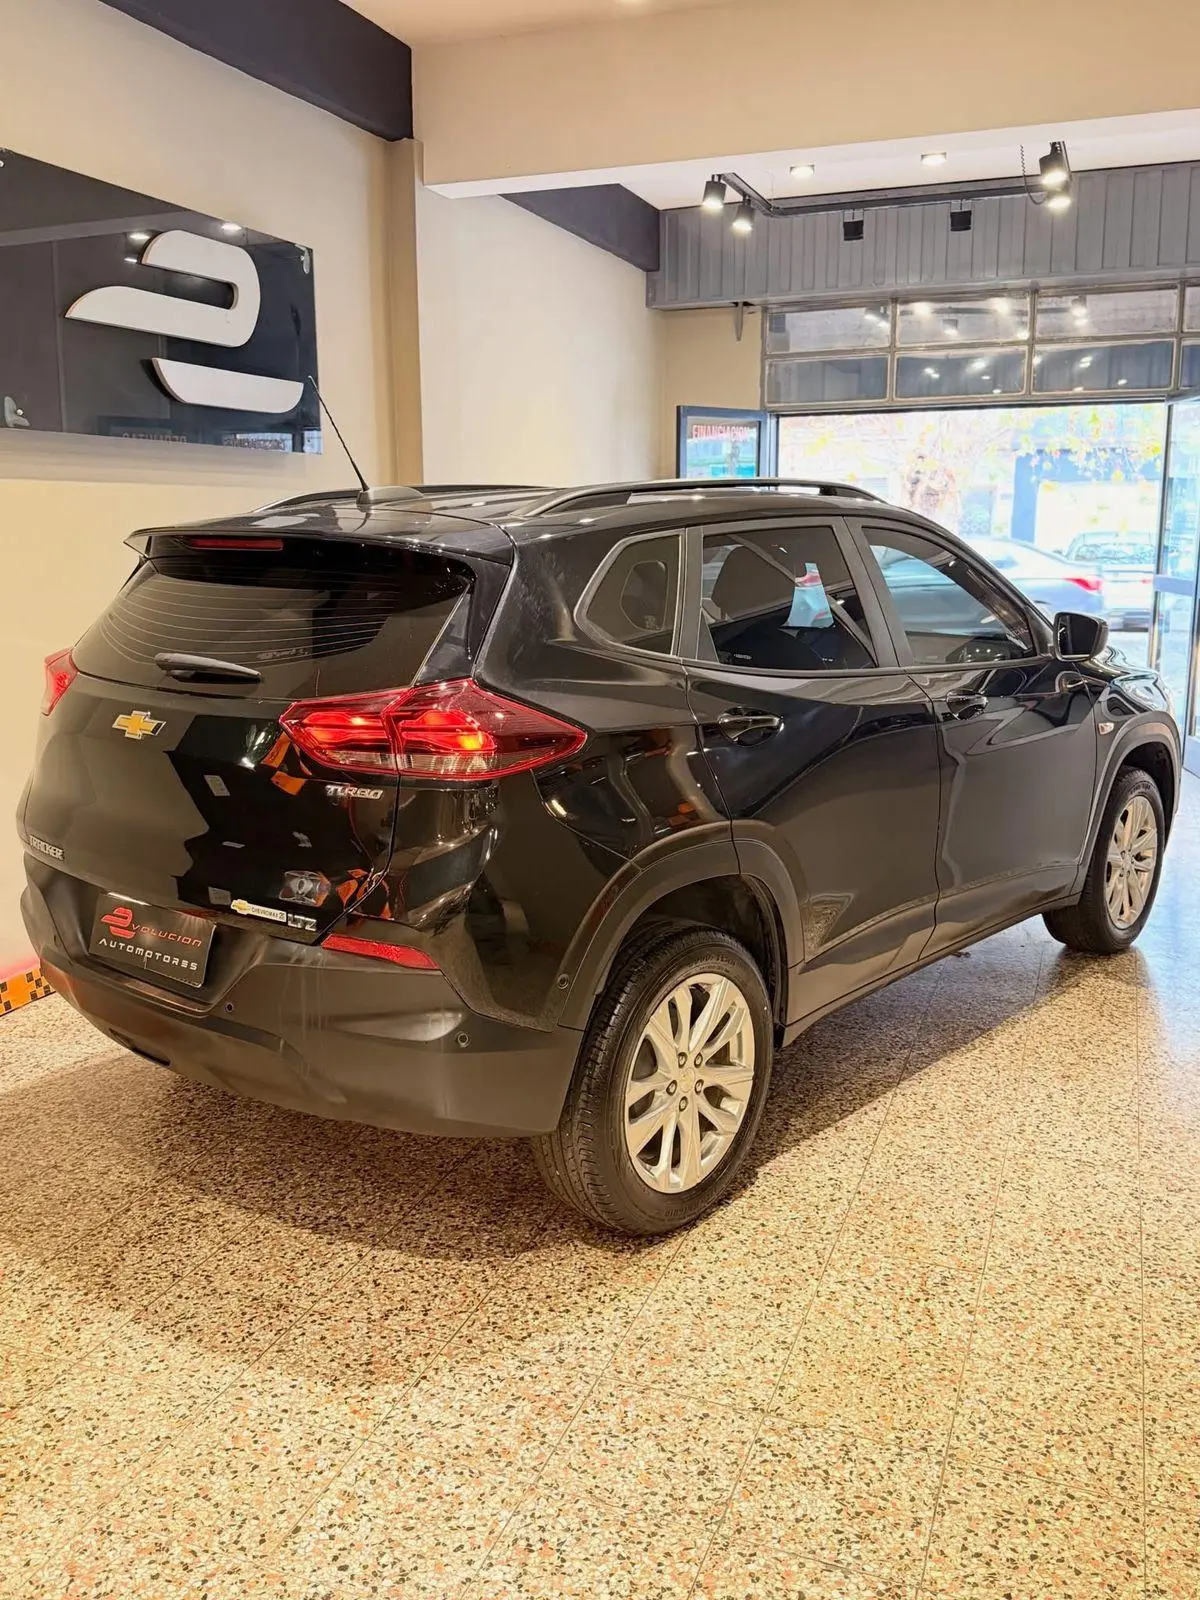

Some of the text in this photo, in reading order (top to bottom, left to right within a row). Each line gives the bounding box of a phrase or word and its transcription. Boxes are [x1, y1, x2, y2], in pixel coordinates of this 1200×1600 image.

[325, 785, 384, 799] TURBO
[29, 834, 64, 861] TRACKER
[287, 913, 317, 931] LTZ
[99, 938, 198, 971] AUTOMOTORES
